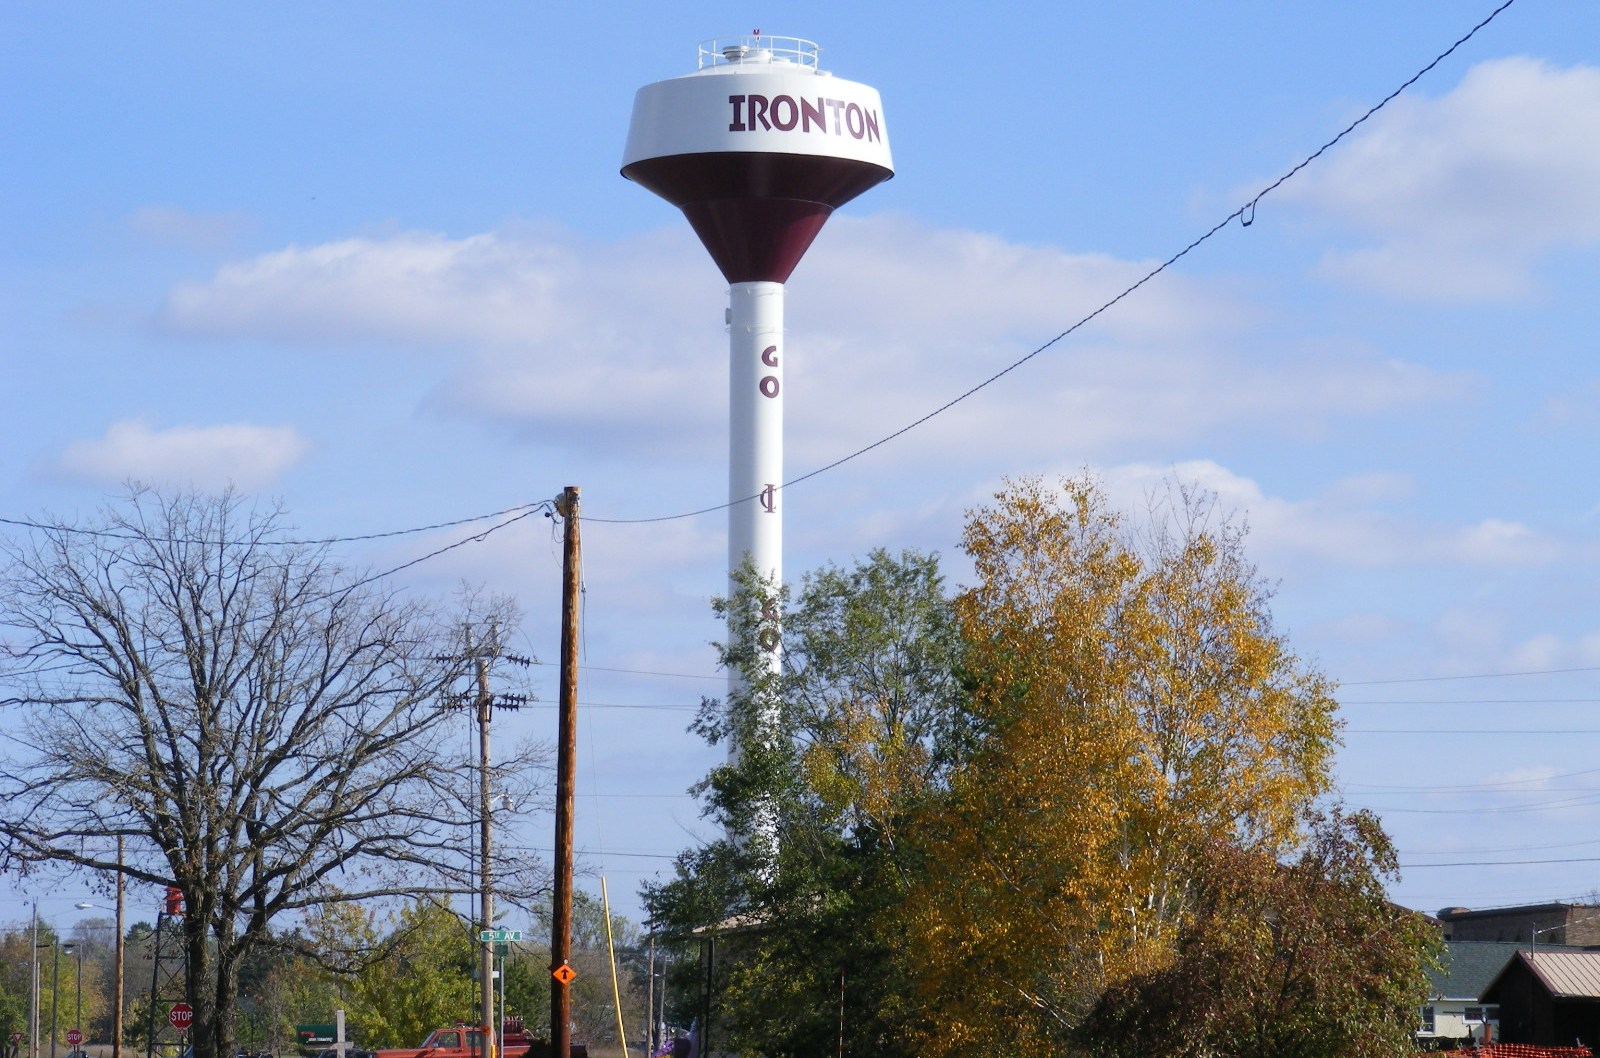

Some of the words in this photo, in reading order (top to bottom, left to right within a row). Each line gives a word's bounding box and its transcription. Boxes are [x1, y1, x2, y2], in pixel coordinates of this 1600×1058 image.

[729, 94, 881, 145] IRONTON
[759, 345, 780, 399] GO
[171, 1011, 193, 1021] STOP
[67, 1033, 82, 1041] STOP
